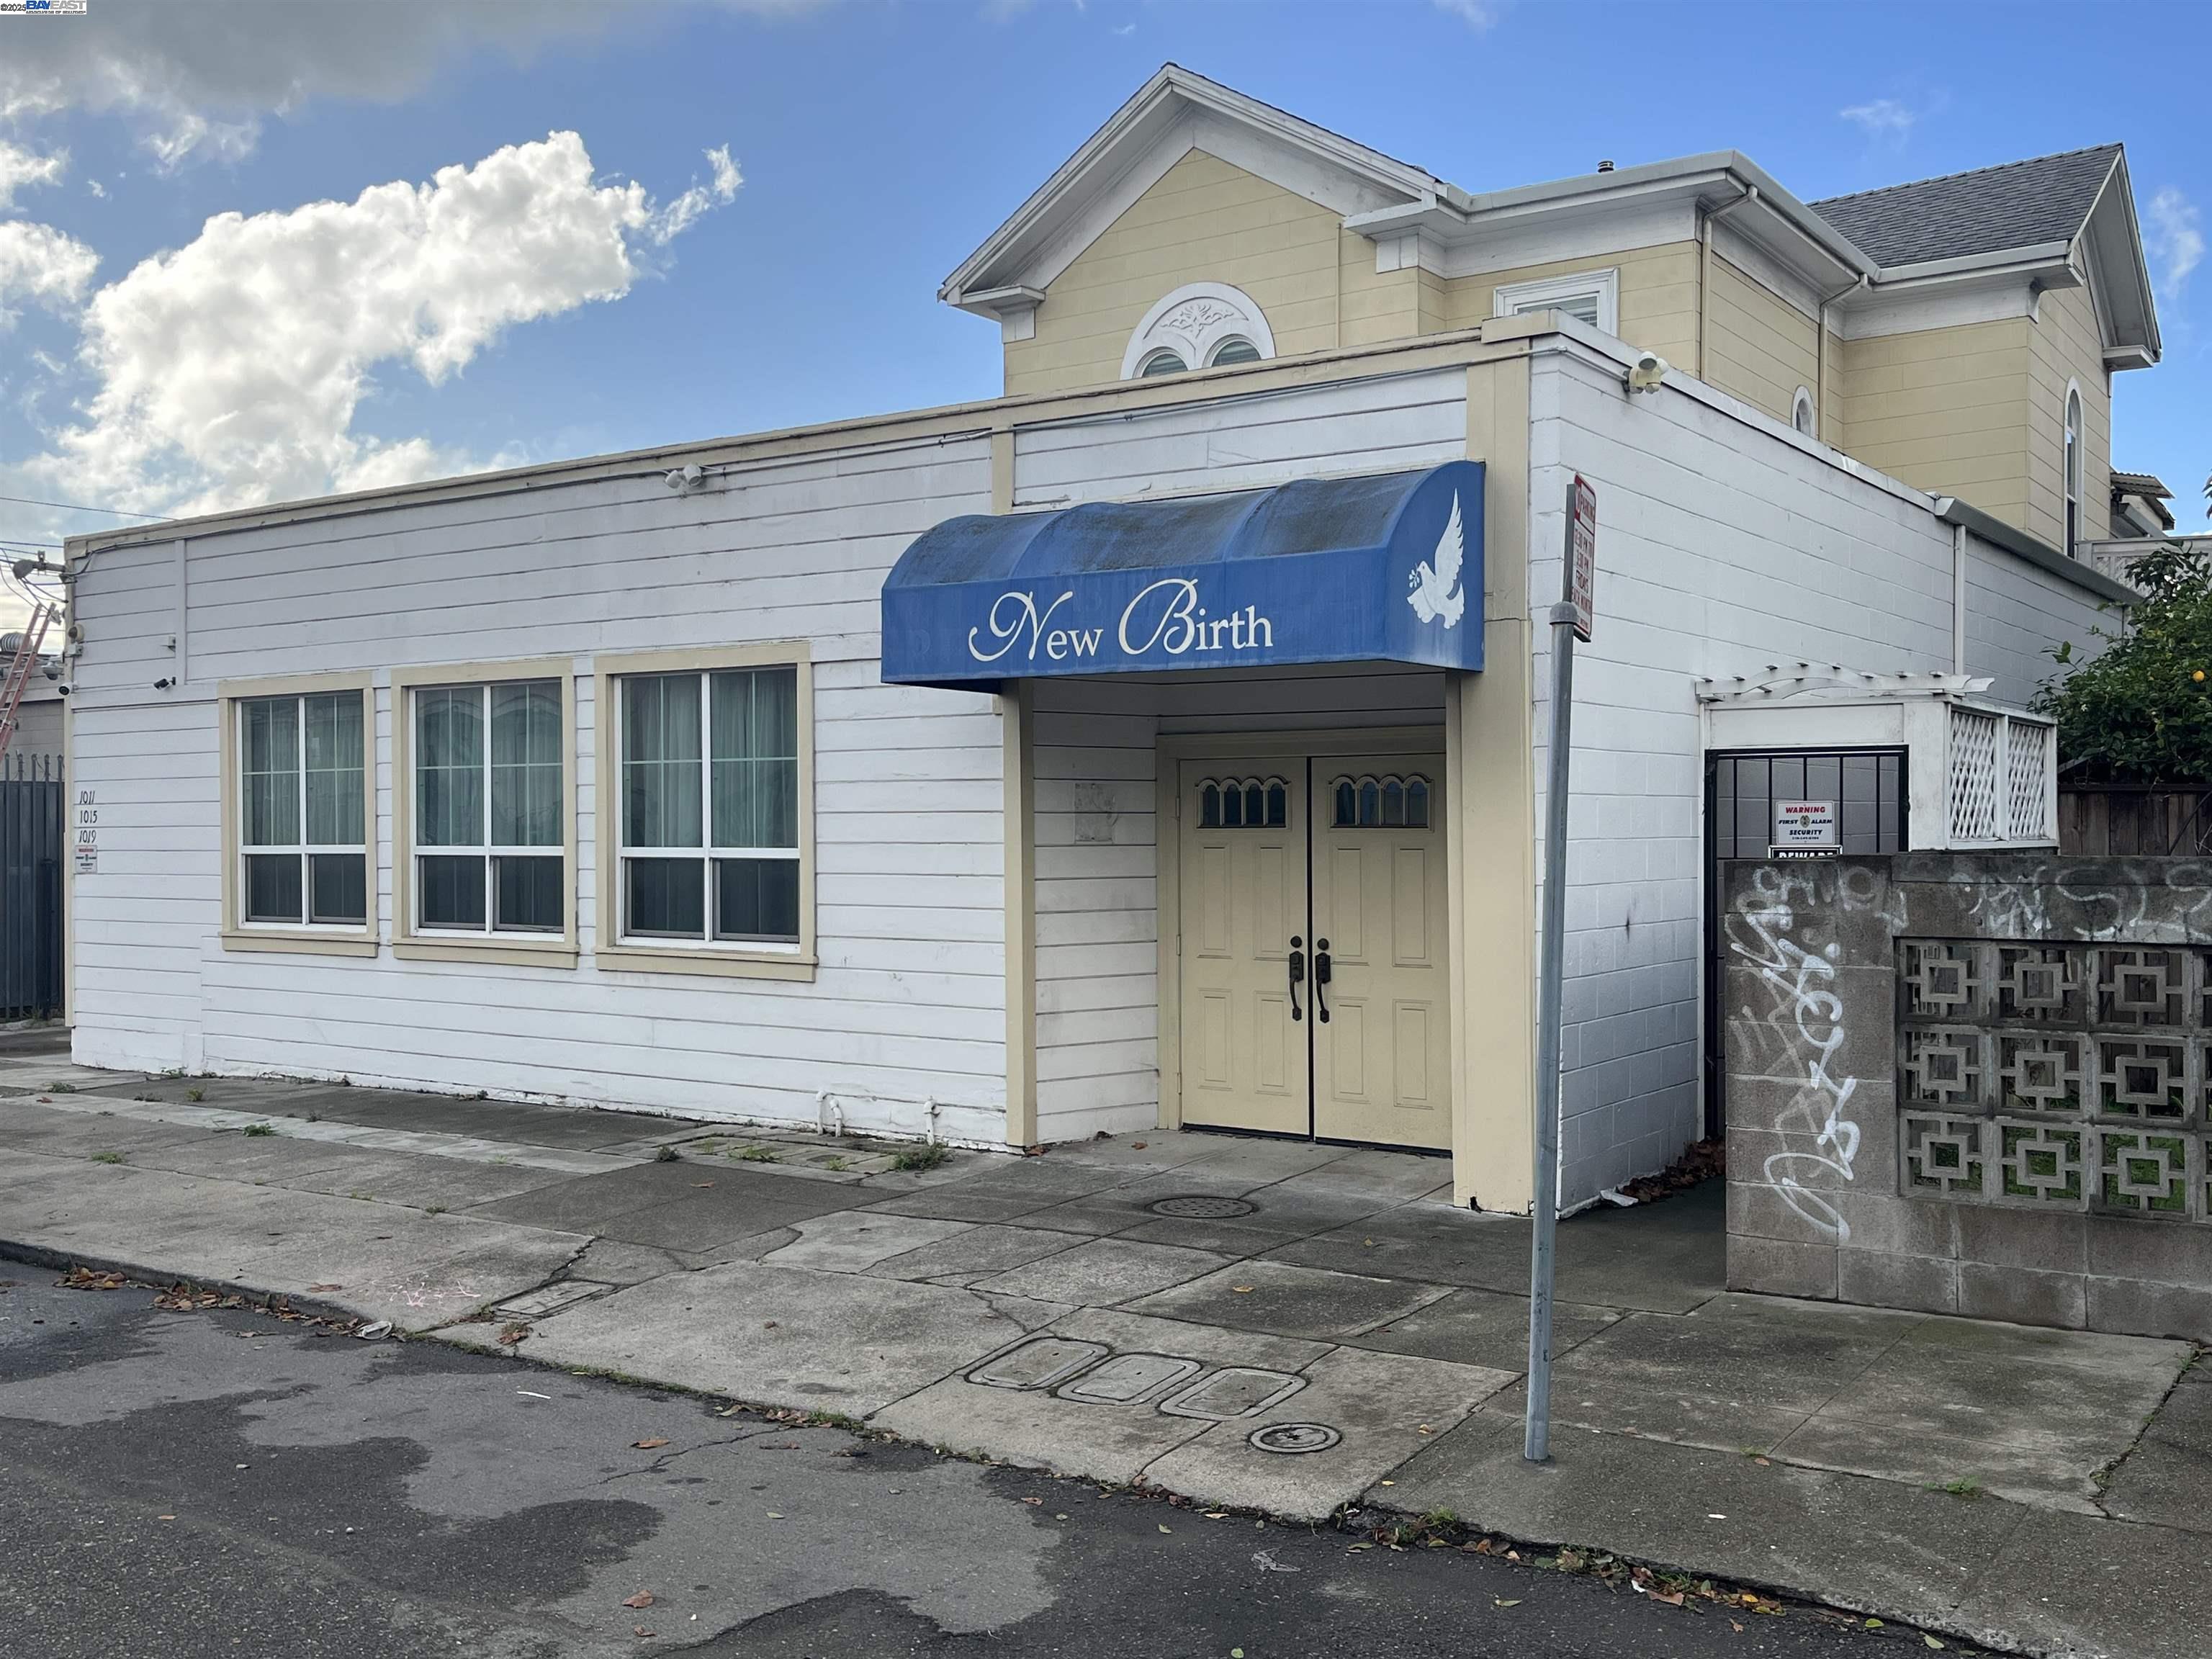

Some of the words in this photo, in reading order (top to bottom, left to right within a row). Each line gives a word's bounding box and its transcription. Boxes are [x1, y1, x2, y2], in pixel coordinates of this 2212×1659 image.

[968, 590, 1104, 662] New
[1118, 578, 1273, 655] Birth
[80, 791, 95, 804] 1011
[80, 810, 97, 824] 1015
[79, 830, 96, 843] 1019
